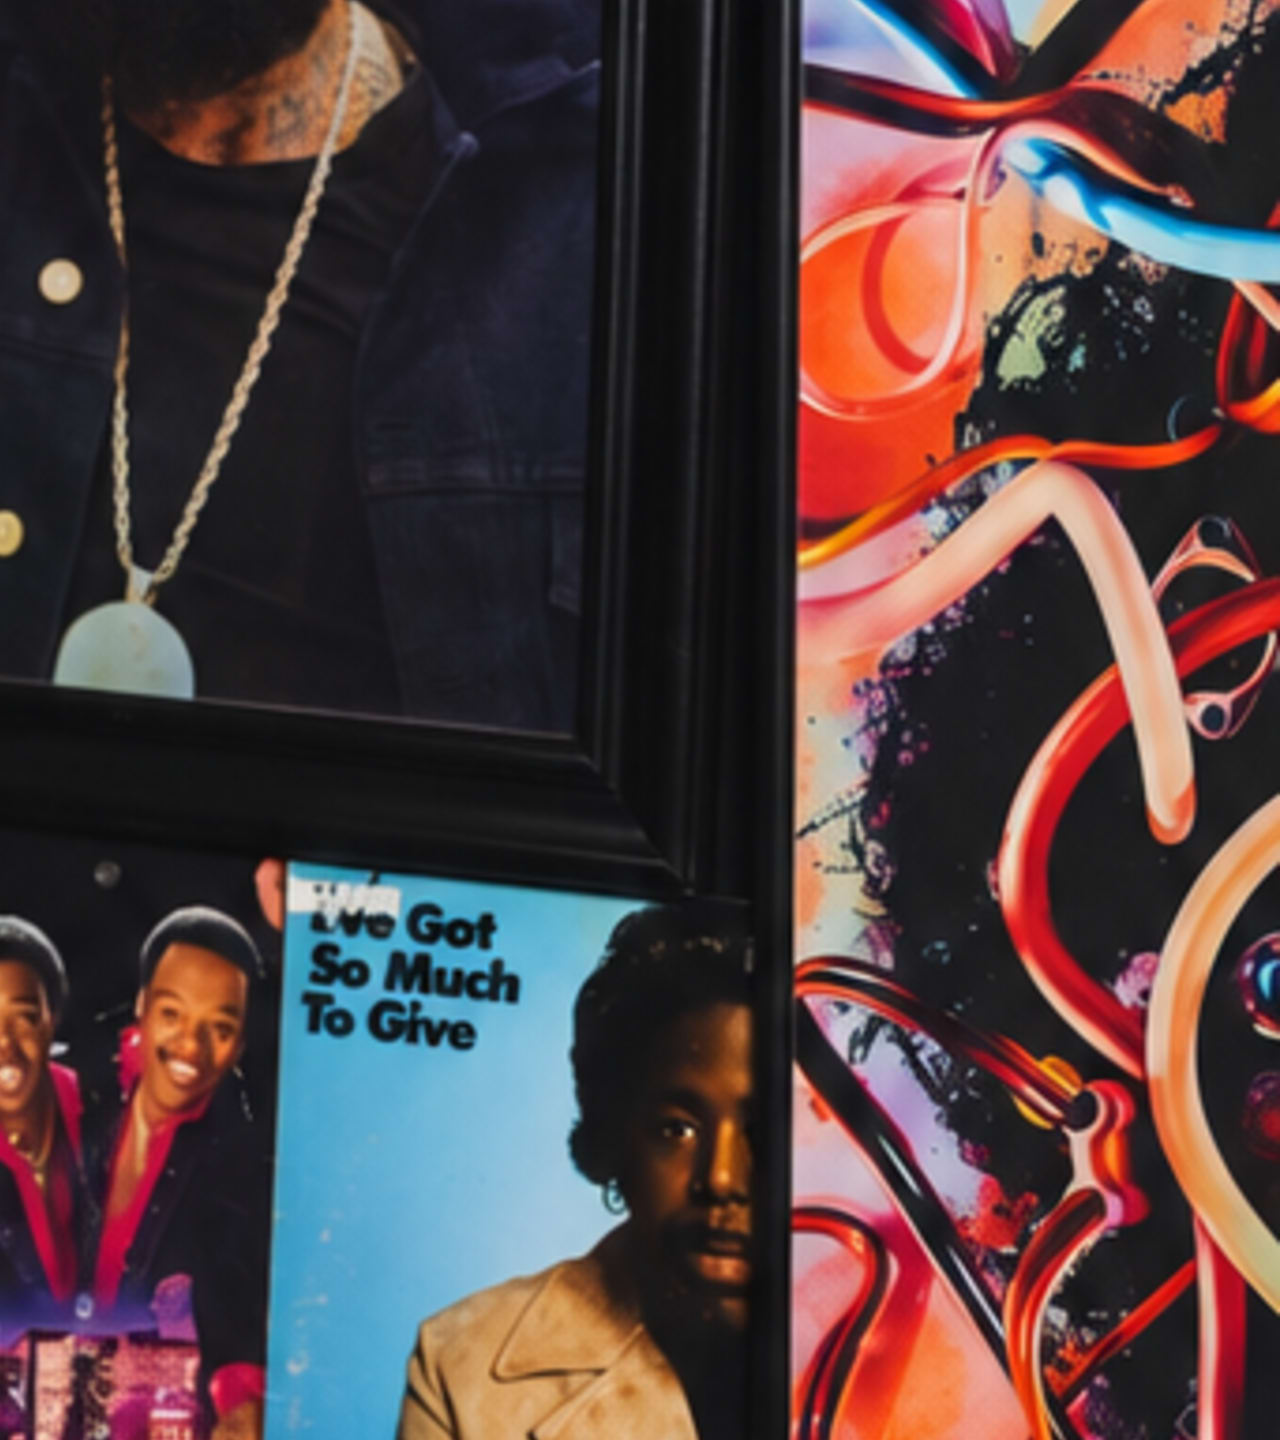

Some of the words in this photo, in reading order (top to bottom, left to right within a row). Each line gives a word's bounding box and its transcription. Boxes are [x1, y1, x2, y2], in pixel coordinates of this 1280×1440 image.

[405, 901, 497, 950] Got
[308, 942, 371, 989] So
[383, 949, 521, 1005] Much
[300, 990, 356, 1038] To
[366, 998, 478, 1051] Give
